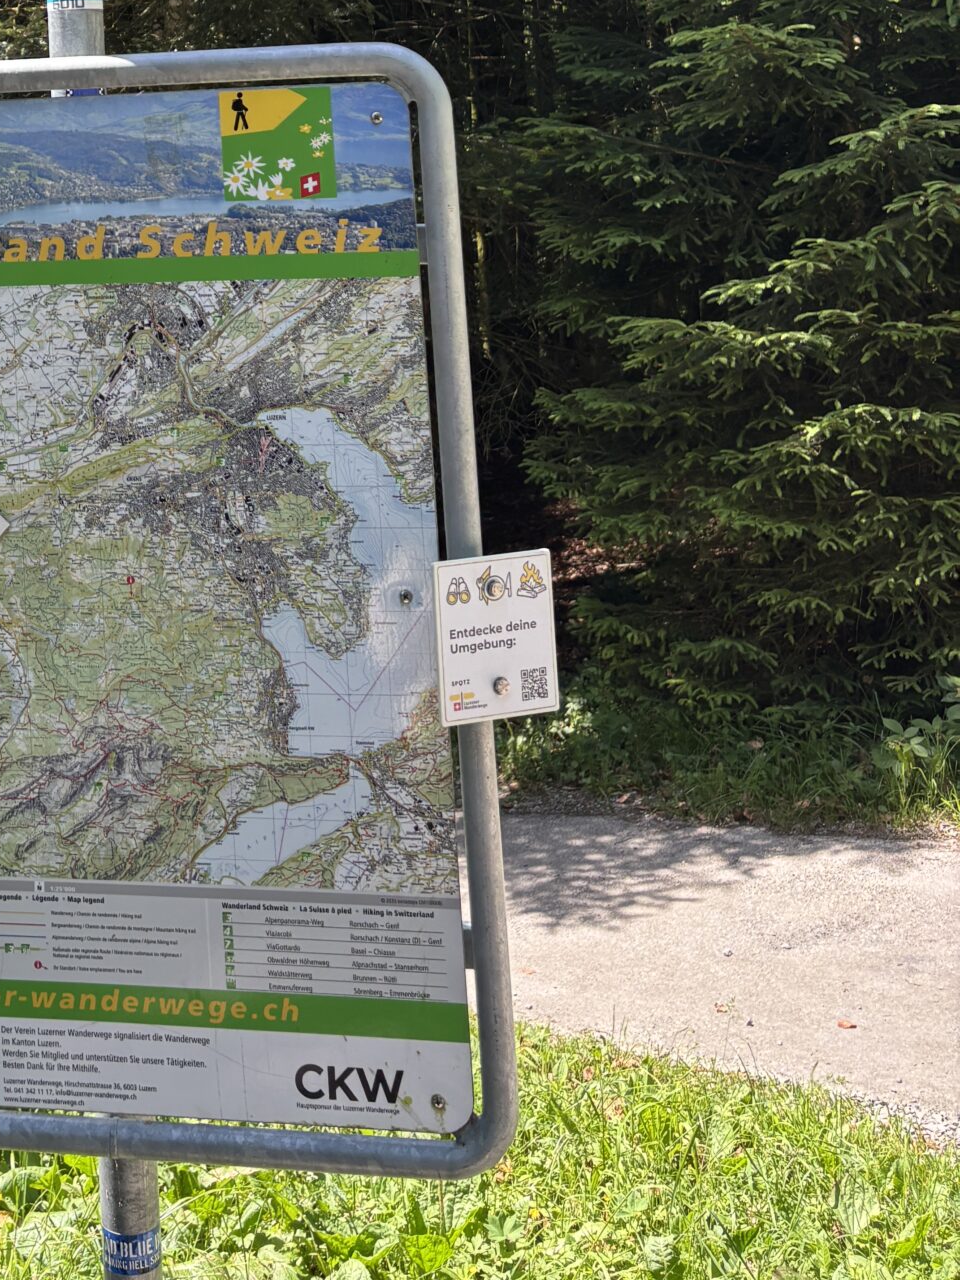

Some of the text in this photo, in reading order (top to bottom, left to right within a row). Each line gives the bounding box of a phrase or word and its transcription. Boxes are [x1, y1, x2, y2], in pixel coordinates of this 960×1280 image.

[137, 219, 383, 259] Schweiz
[449, 619, 537, 640] Entdecke deine
[450, 637, 516, 654] Umgebung:
[67, 896, 81, 905] Map
[83, 897, 104, 905] legend
[222, 902, 260, 910] Wanderland
[363, 909, 384, 917] Hiking
[394, 909, 434, 918] Switzerland
[1, 1026, 210, 1046] Der Verein Luzerner Wanderwege signalisiert die Wanderwege
[2, 1037, 62, 1048] im Kanton Luzern.
[2, 1049, 28, 1058] Werden
[29, 1050, 40, 1058] Sie
[42, 1051, 69, 1061] Mitglied
[70, 1052, 84, 1060] und
[85, 1054, 128, 1063] unterstützen
[130, 1055, 140, 1064] Sie
[166, 1057, 207, 1068] Tätigkeiten.
[3, 1061, 100, 1073] Besten Dank für Ihre Mithilfe.
[3, 1077, 26, 1085] Luzerner
[139, 1084, 157, 1092] Luzern
[295, 1064, 404, 1104] CKW
